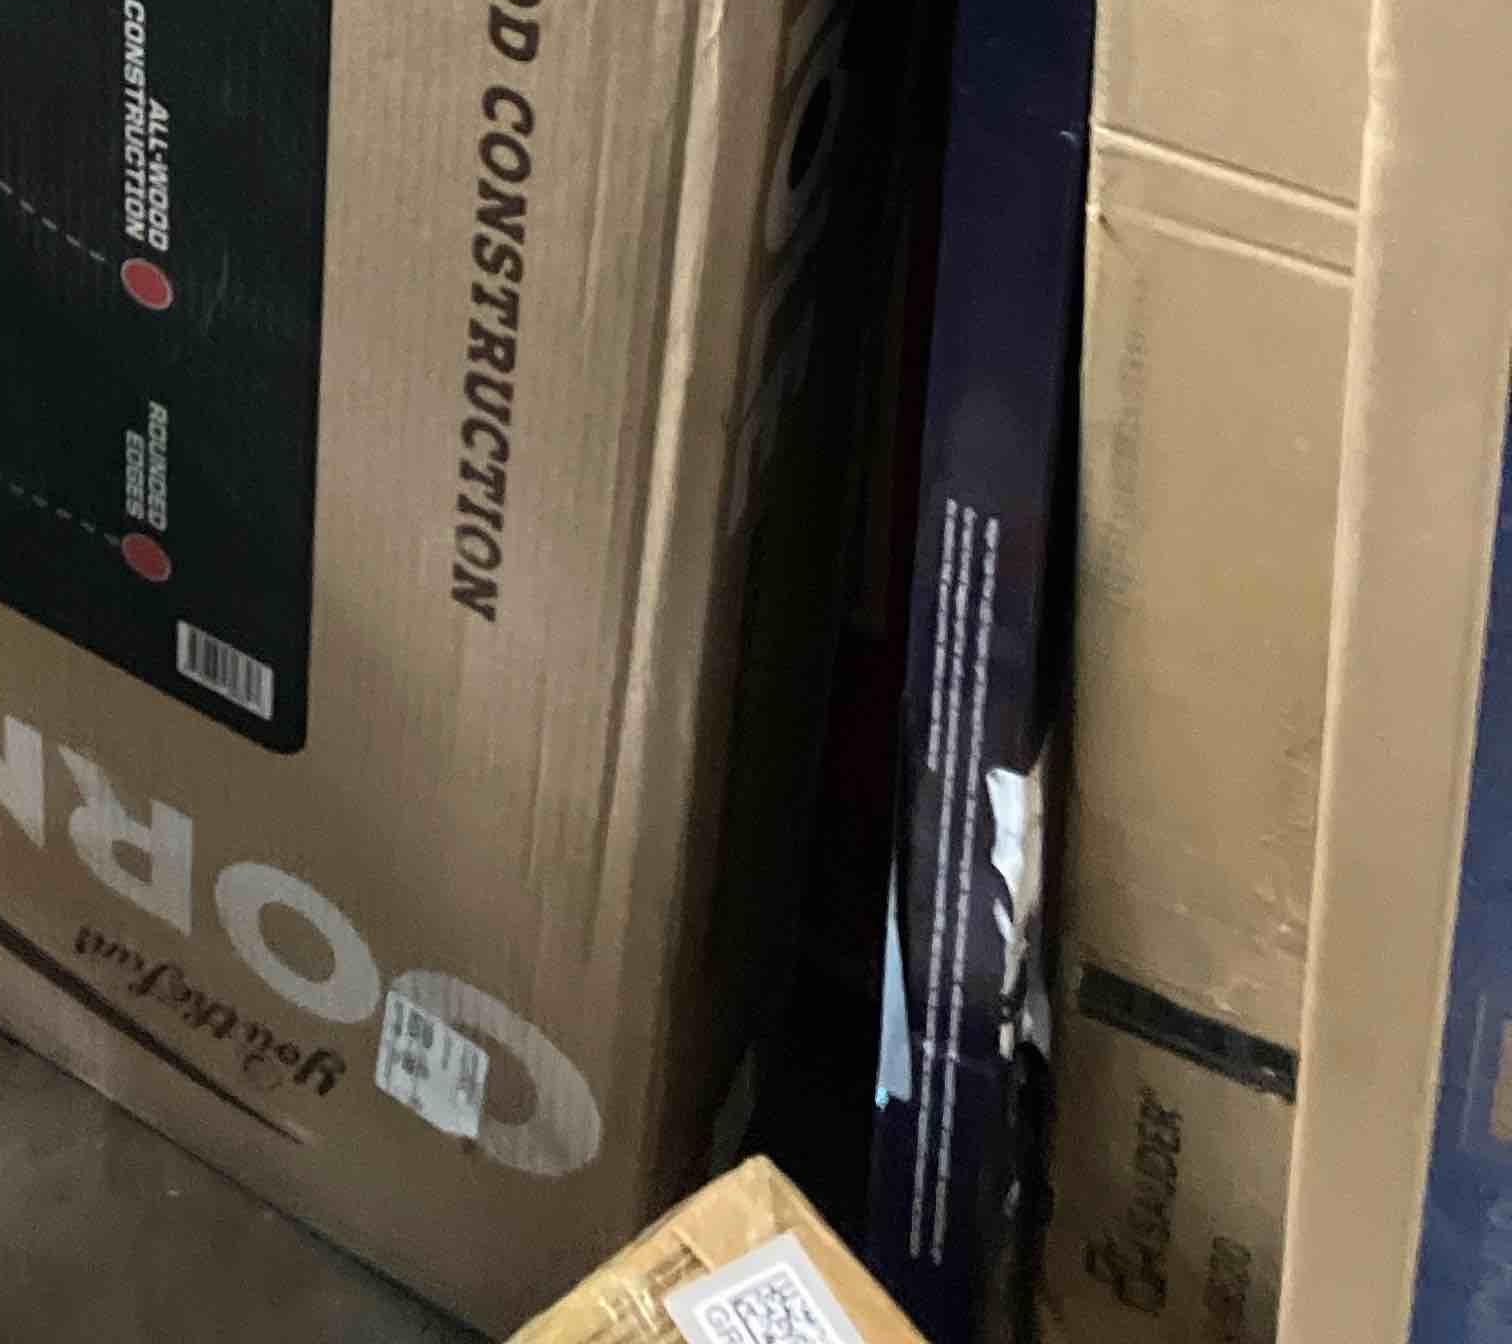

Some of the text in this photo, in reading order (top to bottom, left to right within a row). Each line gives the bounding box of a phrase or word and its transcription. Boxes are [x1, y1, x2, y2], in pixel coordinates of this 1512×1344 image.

[148, 97, 170, 253] ALL-WOOD
[449, 84, 536, 623] CONSTRUCTION
[124, 428, 145, 520] EDGES
[148, 399, 169, 532] ROUNDED
